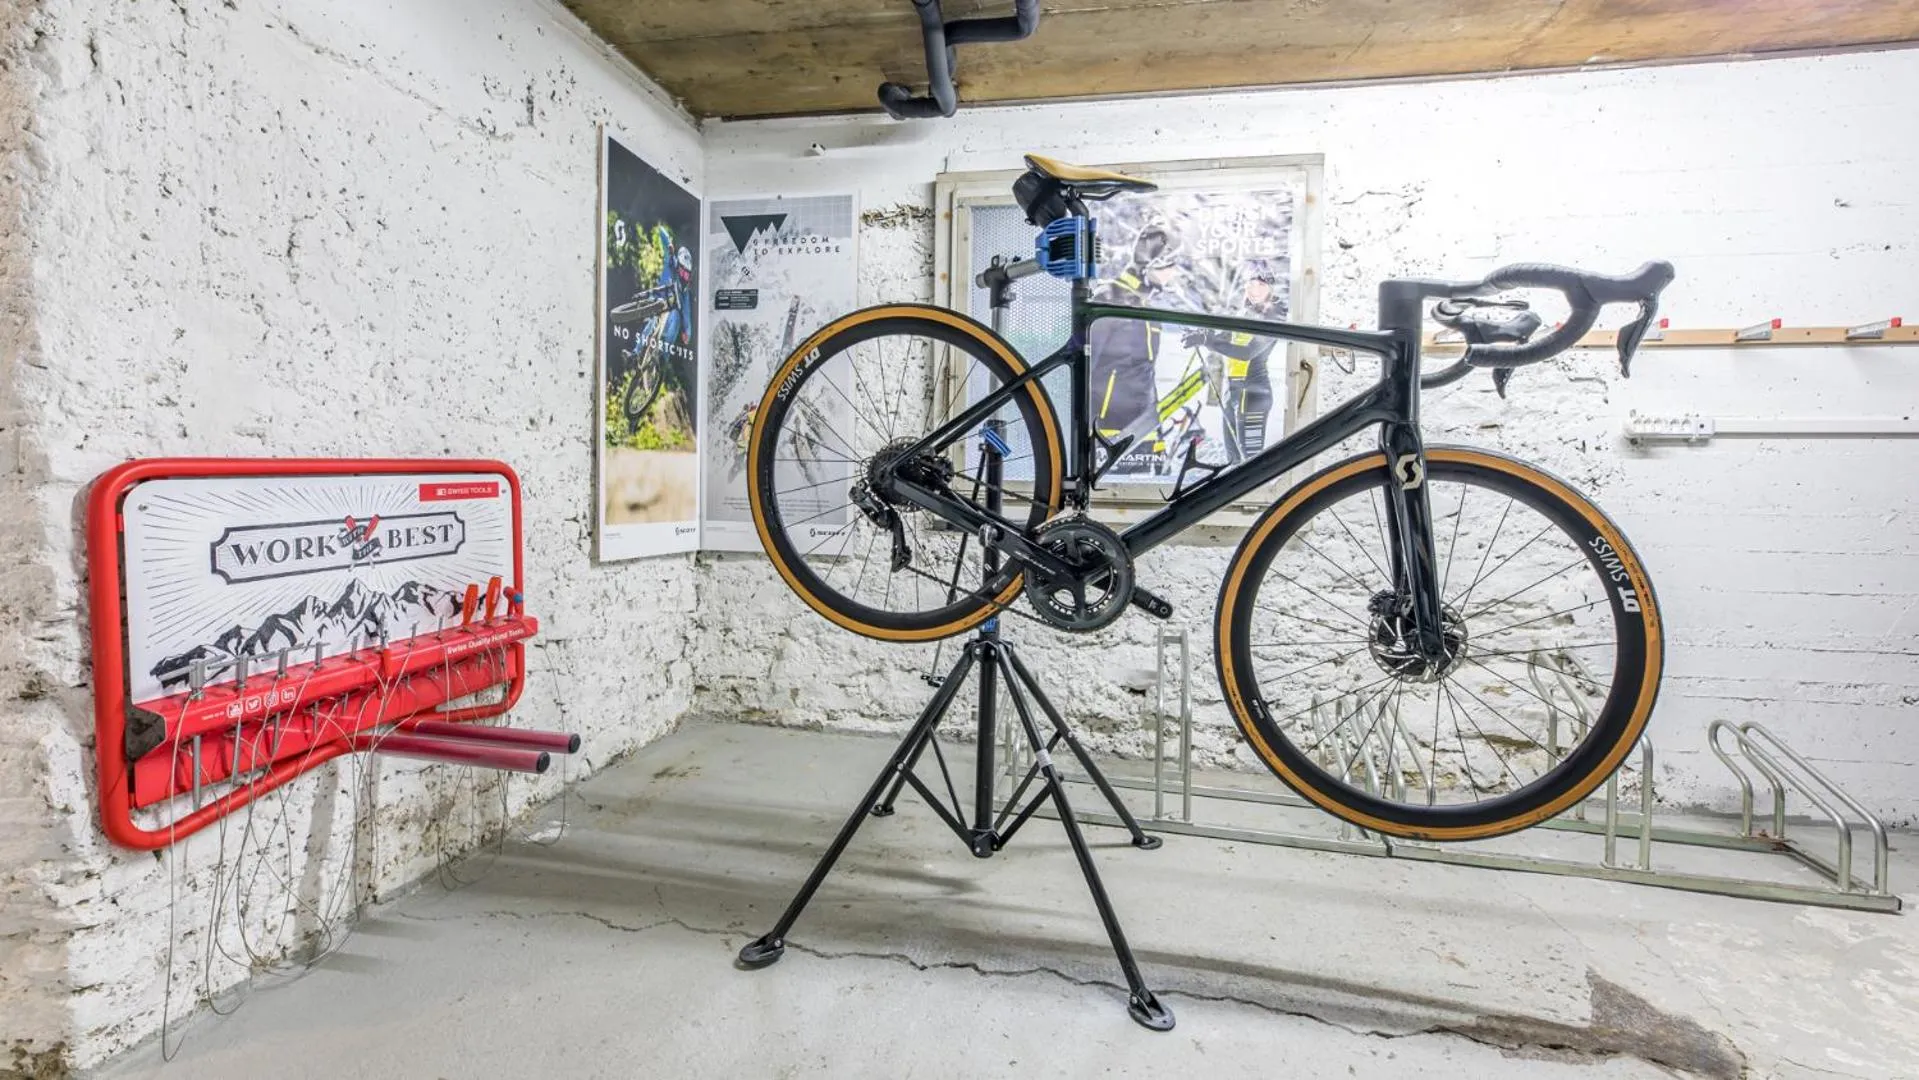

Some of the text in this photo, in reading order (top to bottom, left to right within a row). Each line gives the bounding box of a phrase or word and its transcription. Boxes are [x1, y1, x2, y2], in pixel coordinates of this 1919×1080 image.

[1199, 221, 1257, 238] YOUR
[764, 237, 829, 246] FREEDOM
[779, 246, 840, 255] EXPLORE
[614, 325, 629, 339] NO
[777, 346, 821, 402] DT SWISS
[230, 535, 337, 567] WORK
[387, 523, 454, 549] BEST
[1588, 535, 1641, 612] DT SWISS
